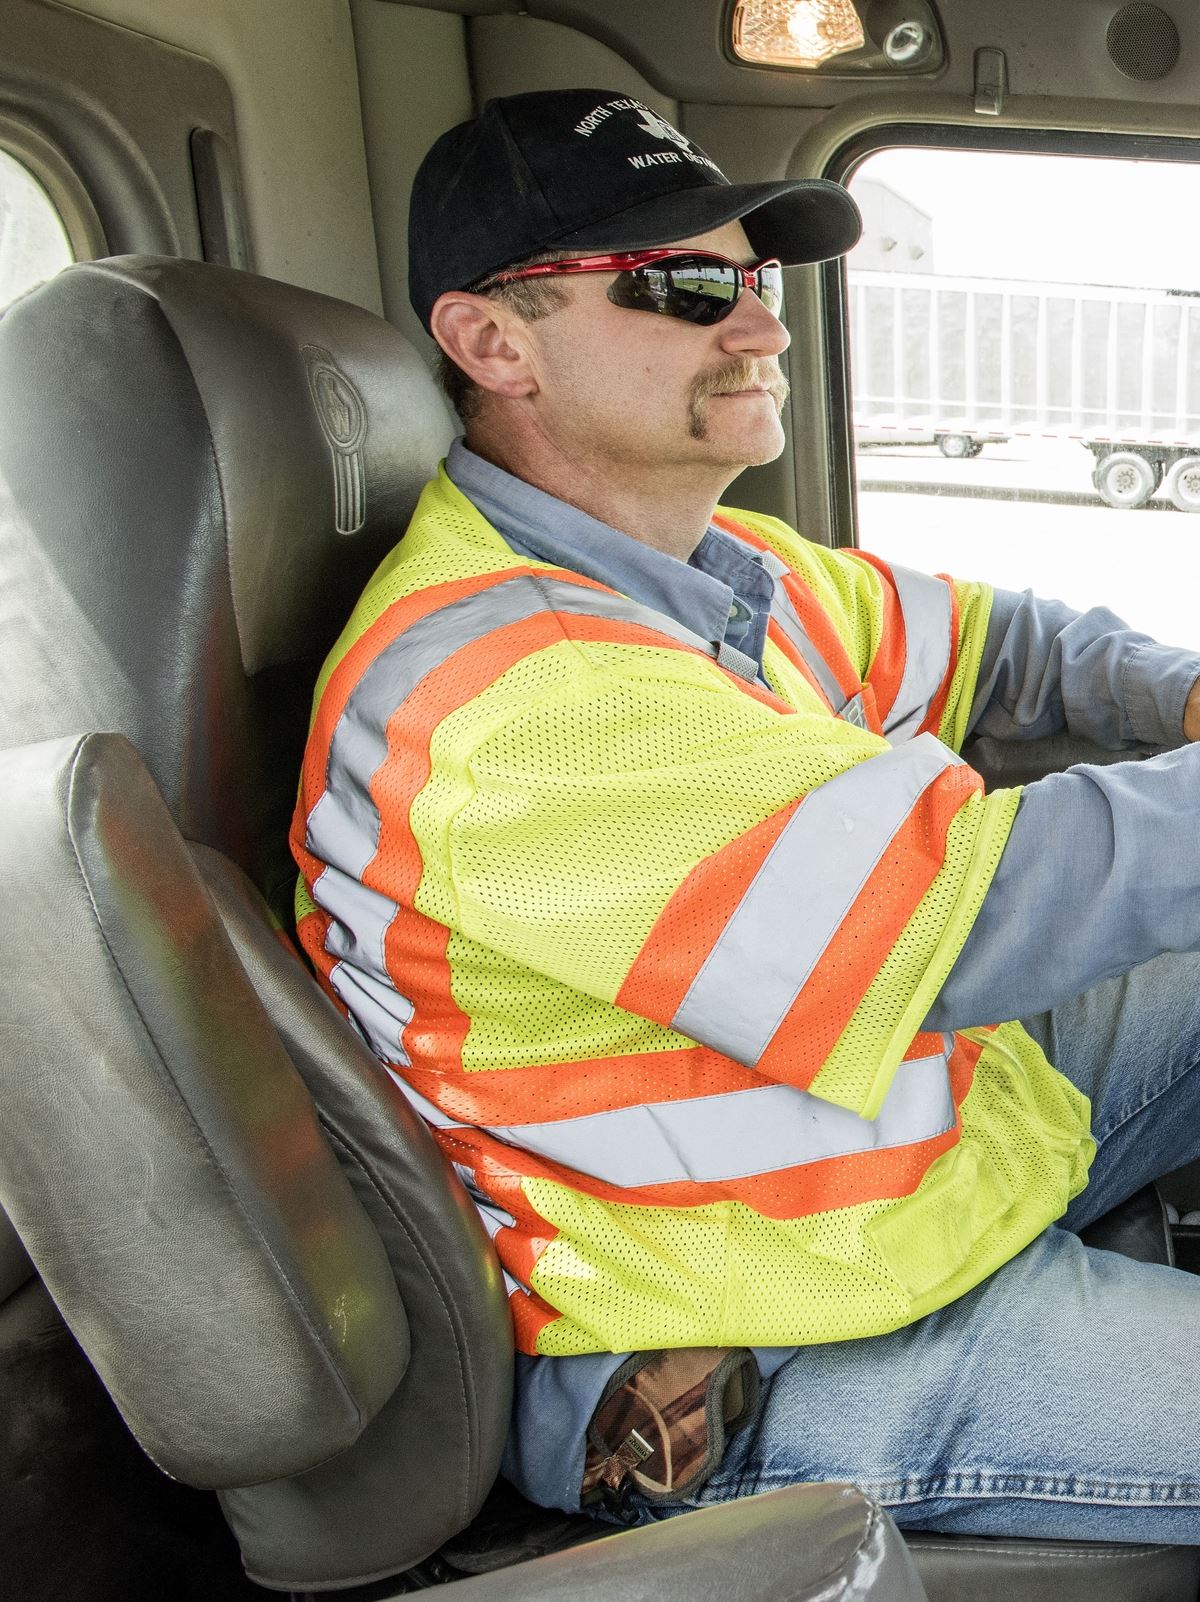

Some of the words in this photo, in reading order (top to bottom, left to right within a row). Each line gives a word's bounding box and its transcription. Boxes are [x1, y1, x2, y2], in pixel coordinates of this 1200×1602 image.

[574, 105, 613, 138] NORTH
[606, 98, 649, 111] TEXAS
[627, 152, 682, 170] WATER
